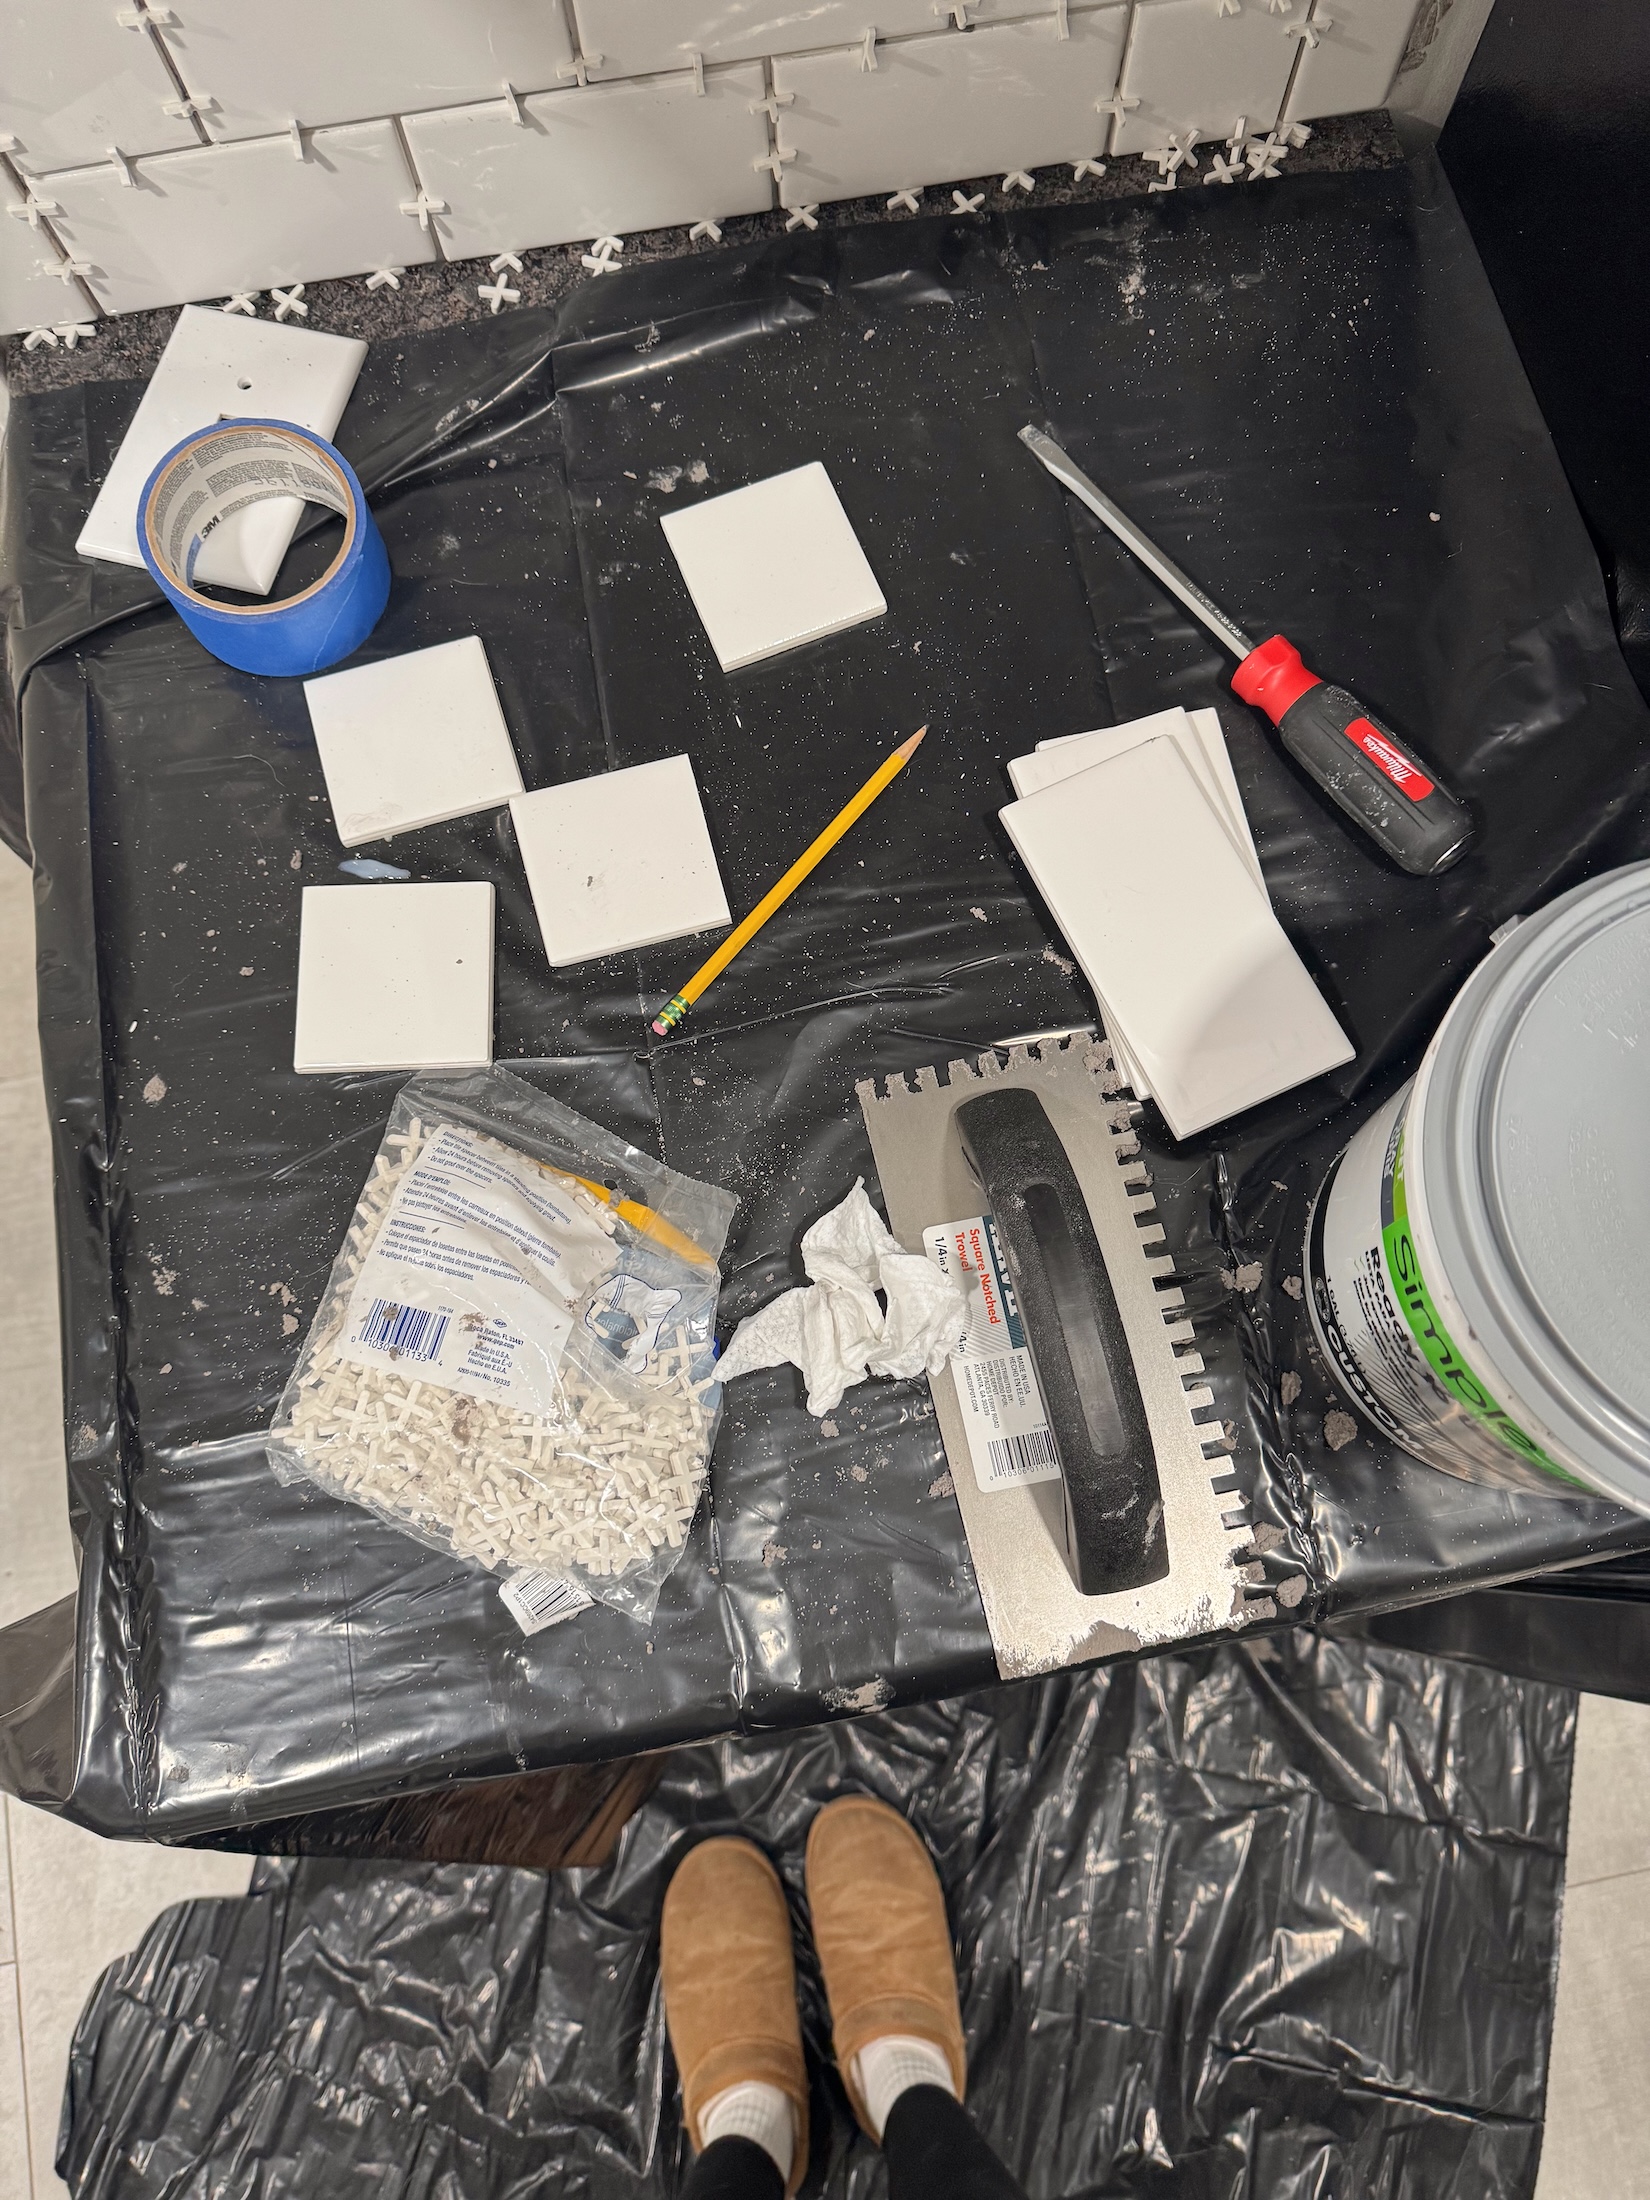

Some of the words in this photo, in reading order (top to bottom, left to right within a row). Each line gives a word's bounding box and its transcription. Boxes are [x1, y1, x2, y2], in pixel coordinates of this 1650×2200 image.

[201, 515, 221, 539] 3M
[1360, 734, 1413, 786] Milwaukee
[455, 1162, 466, 1170] over
[465, 1166, 474, 1174] the
[473, 1172, 492, 1183] spacers.
[476, 1155, 495, 1166] between
[529, 1192, 547, 1204] position
[454, 1153, 466, 1161] hours
[467, 1159, 481, 1168] before
[481, 1166, 502, 1179] removing
[526, 1196, 543, 1213] applying
[542, 1210, 555, 1221] grout.
[421, 1190, 430, 1198] 24
[428, 1193, 444, 1204] heures
[444, 1201, 457, 1211] avant
[447, 1192, 460, 1200] entre
[468, 1201, 489, 1216] carreaux
[495, 1215, 513, 1228] position
[513, 1225, 527, 1237] debout
[526, 1233, 541, 1244] (pierre
[409, 1235, 431, 1245] espaciador
[438, 1242, 454, 1251] losetas
[475, 1253, 492, 1262] losetas
[933, 1236, 948, 1256] 1/4
[954, 1231, 971, 1271] Trowel
[378, 1248, 386, 1256] No
[385, 1251, 402, 1260] aplique
[444, 1268, 474, 1280] espaciadores.
[408, 1246, 421, 1254] pasen
[442, 1255, 454, 1263] antes
[461, 1261, 480, 1270] remover
[489, 1269, 519, 1281] espaciadores
[938, 1256, 947, 1265] in
[969, 1228, 986, 1271] Square
[979, 1273, 1001, 1324] Notched
[1365, 1250, 1375, 1286] LISTA
[1373, 1292, 1391, 1329] PARA
[1329, 1289, 1340, 1320] GAL
[1369, 1245, 1421, 1363] Ready
[476, 1333, 514, 1349] www.qep.com
[958, 1343, 968, 1353] in
[1393, 1233, 1537, 1451] Simple
[397, 1346, 428, 1362] 01133
[437, 1359, 443, 1367] 4
[467, 1349, 490, 1361] Fabriqué
[467, 1357, 483, 1366] Hecho
[972, 1362, 984, 1391] ATLANTA,
[979, 1361, 987, 1376] 2455
[986, 1360, 994, 1377] HOME
[998, 1358, 1011, 1393] DISTRIBUTED
[1008, 1356, 1019, 1377] HECHO
[1016, 1354, 1026, 1373] MADE
[1022, 1381, 1030, 1394] USA
[482, 1373, 492, 1381] No.
[493, 1377, 510, 1387] 10335
[963, 1365, 978, 1412] HOMEDEPOT.COM
[982, 1376, 991, 1394] PACES
[989, 1377, 998, 1396] DEPOT
[992, 1359, 1005, 1393] DISTRIBUIDO
[1000, 1394, 1008, 1408] POR:
[1014, 1378, 1021, 1386] EN
[1321, 1321, 1425, 1454] CUSTOM
[979, 1390, 986, 1399] GA
[986, 1394, 995, 1412] FERRY
[1016, 1387, 1025, 1407] EE.UU.
[981, 1399, 990, 1416] 30339
[991, 1412, 999, 1428] ROAD
[1003, 1468, 1027, 1477] 10306
[1030, 1462, 1054, 1472] 01115
